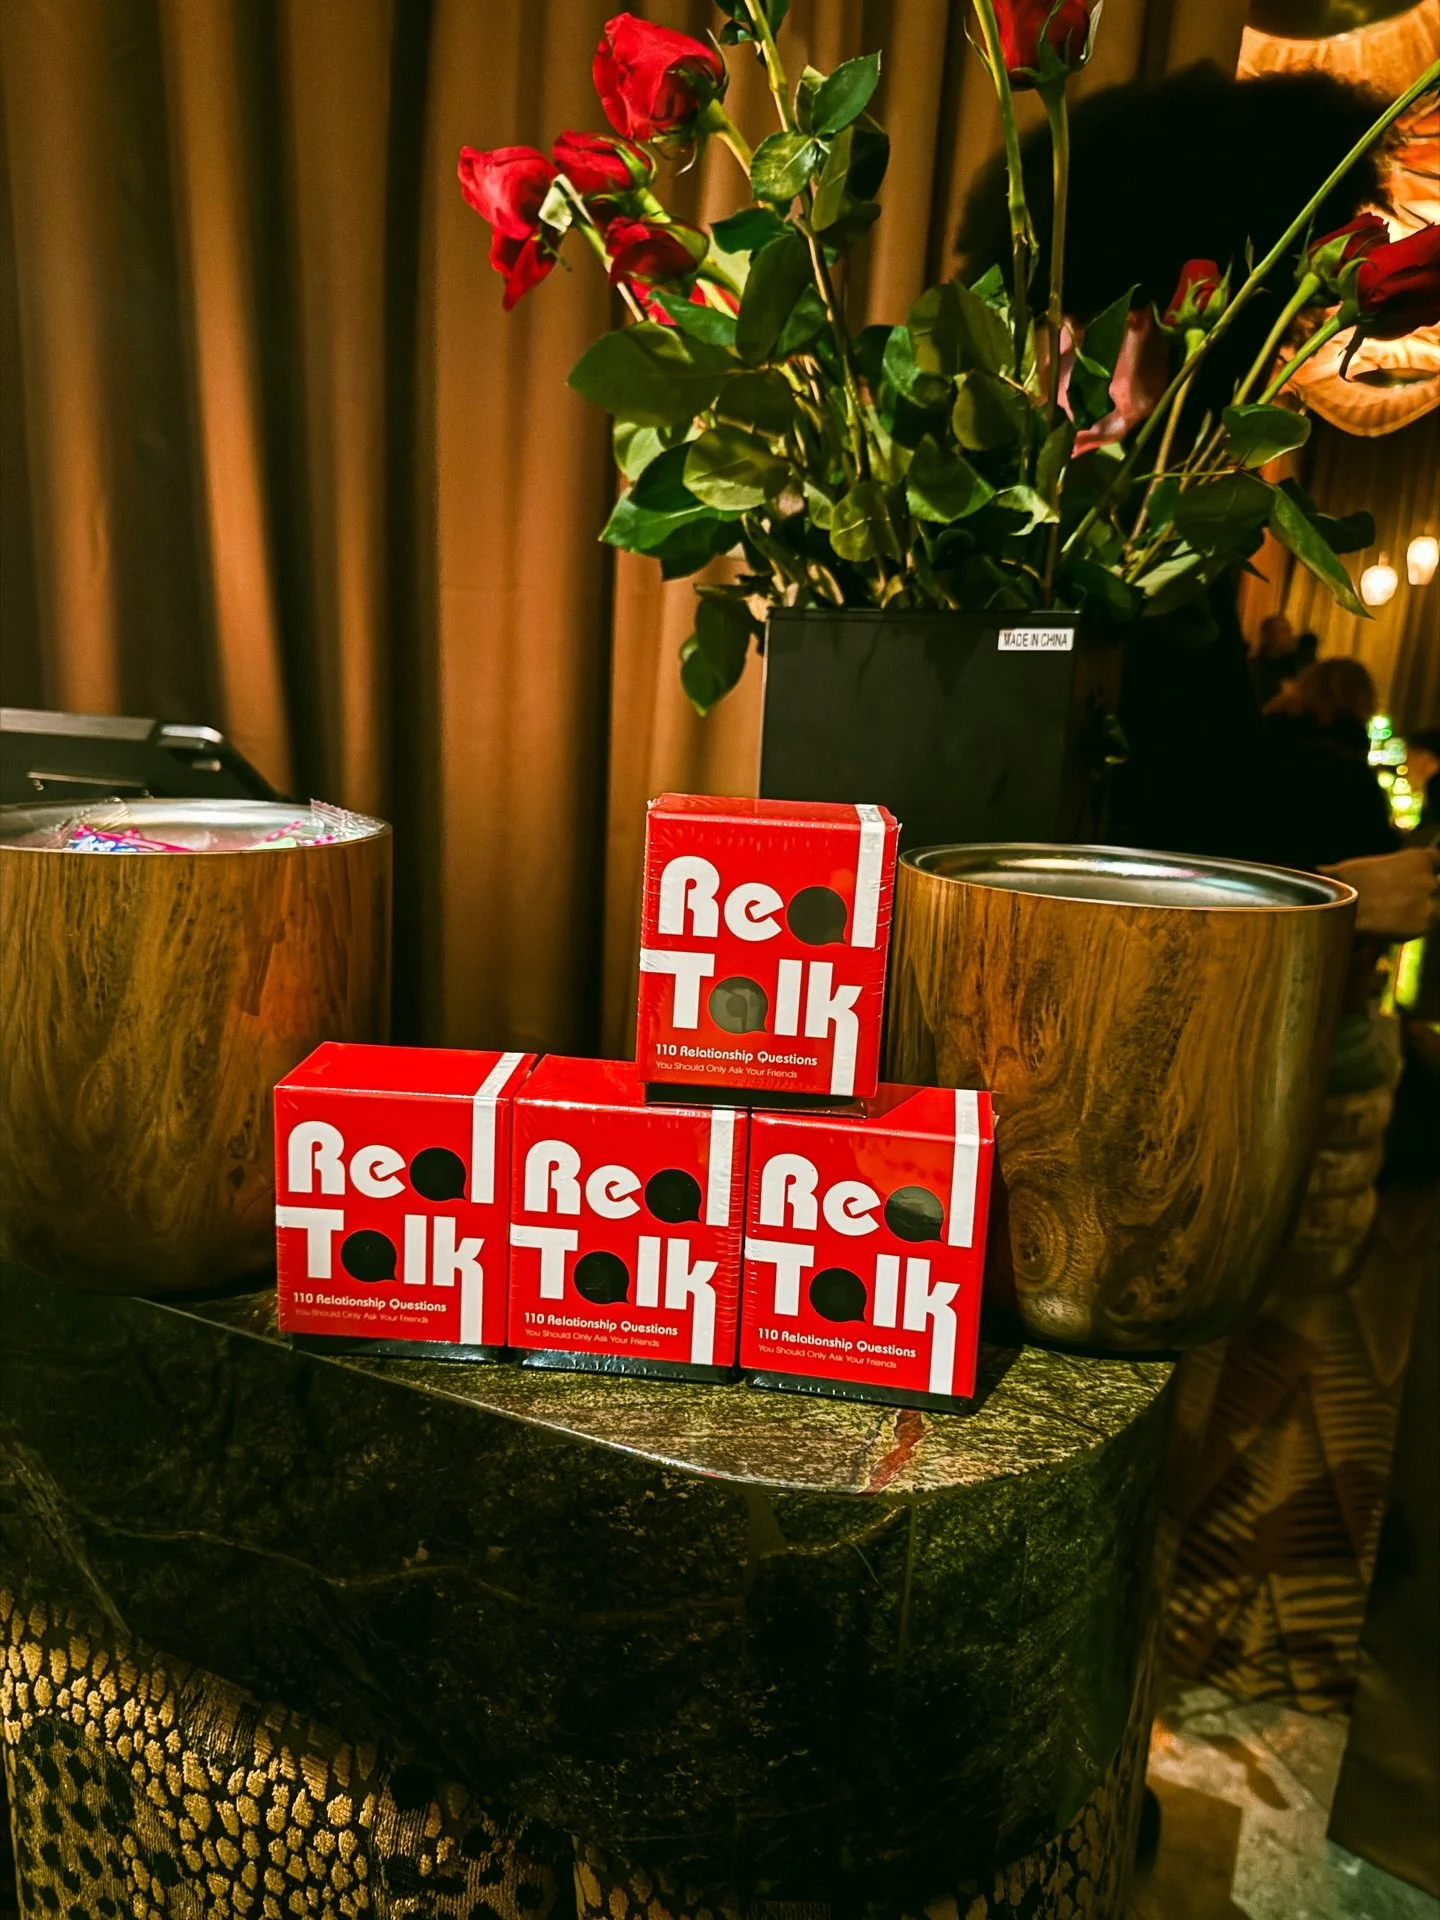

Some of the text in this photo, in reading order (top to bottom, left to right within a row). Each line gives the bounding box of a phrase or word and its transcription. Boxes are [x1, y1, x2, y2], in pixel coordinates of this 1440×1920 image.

[1003, 632, 1068, 647] MADE IN CHINA
[658, 820, 885, 948] Real
[640, 948, 864, 1096] Talk
[656, 1043, 818, 1066] 110 Relationship Questions
[656, 1061, 798, 1079] You Should Only Ask Your Friends
[288, 1098, 496, 1204] Real
[524, 1110, 735, 1227] Real
[759, 1140, 979, 1248] Real
[275, 1205, 485, 1345] Talk
[293, 1292, 447, 1313] 110 Relationship Questions
[510, 1222, 719, 1365] Talk
[525, 1312, 679, 1336] 110 Relationship Questions
[525, 1328, 660, 1348] You Should Only Ask Your Friends
[744, 1236, 960, 1395] Talk
[758, 1327, 917, 1358] 110 Relationship Questions
[758, 1344, 897, 1369] You Should Only Ask Your Friends
